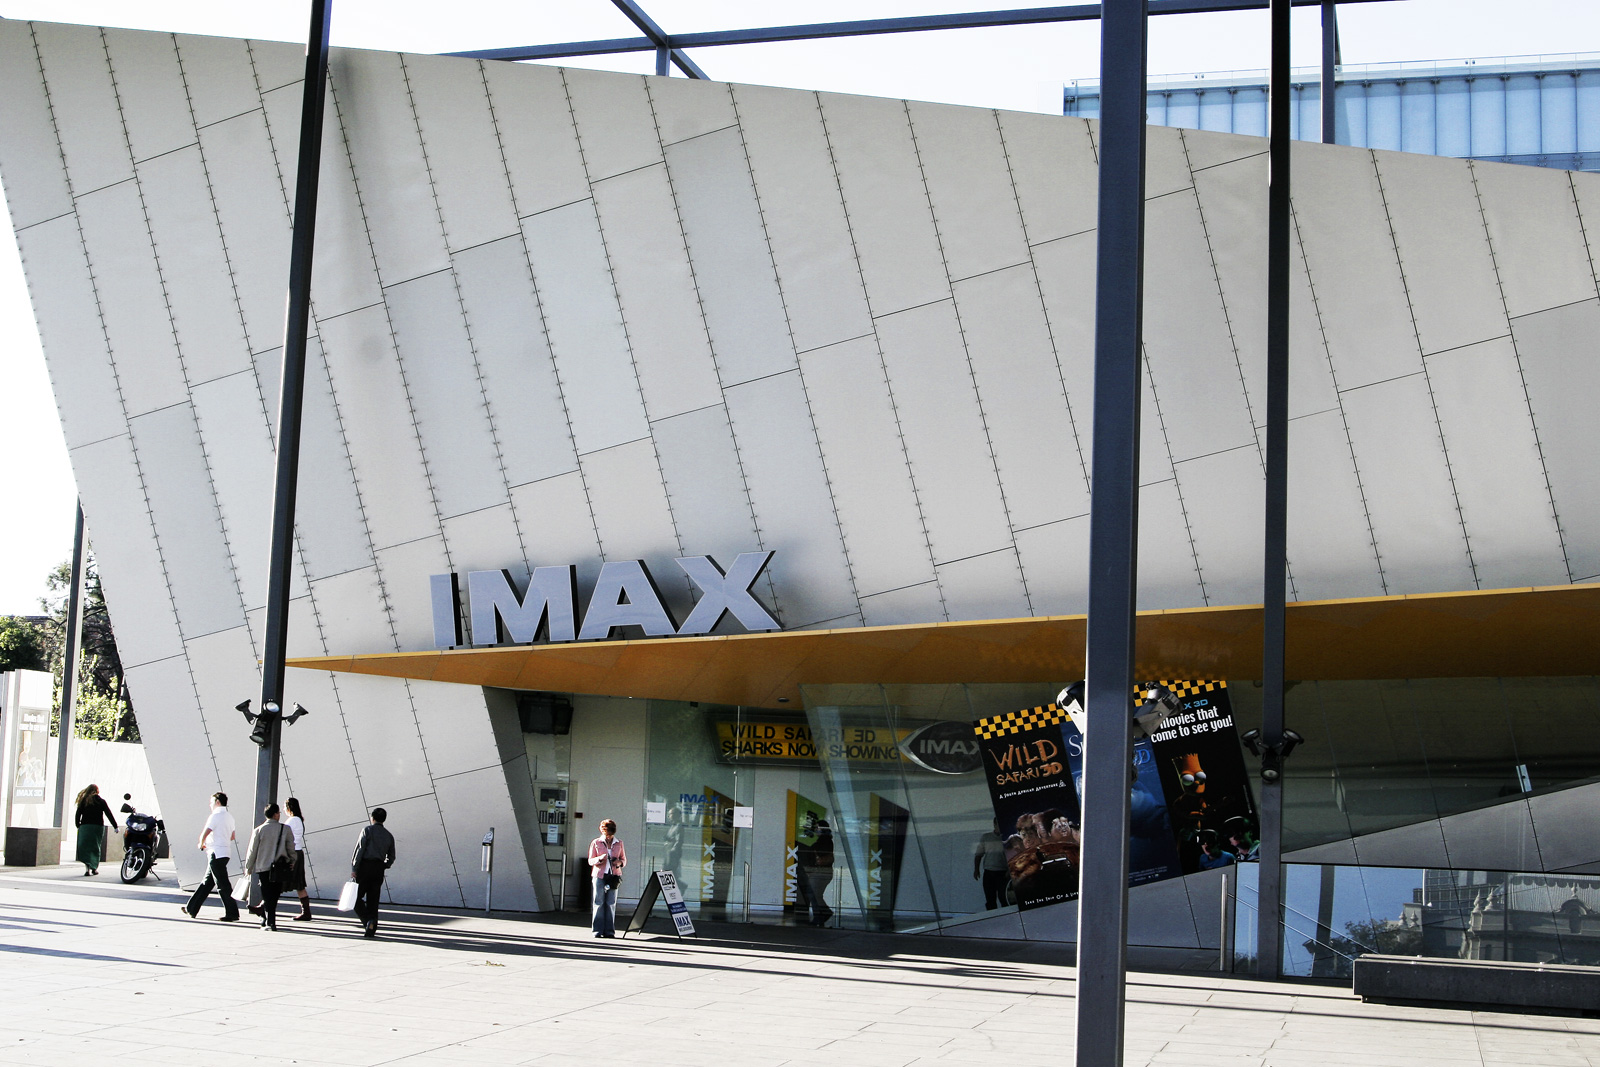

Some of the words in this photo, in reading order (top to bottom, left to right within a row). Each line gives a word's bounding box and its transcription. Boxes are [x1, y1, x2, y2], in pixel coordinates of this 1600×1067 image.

[430, 551, 783, 647] IMAX
[1193, 698, 1209, 708] 3D
[1196, 705, 1219, 721] that
[730, 724, 776, 739] WILD
[784, 726, 845, 743] SAFARI
[1150, 728, 1178, 743] come
[1179, 725, 1190, 737] to
[1191, 723, 1209, 735] see
[1210, 714, 1233, 733] you!
[721, 740, 783, 756] SHARKS
[829, 744, 900, 760] SHOWING
[919, 739, 979, 755] IMAX
[988, 739, 1058, 771] WILD
[996, 767, 1040, 786] SAFARI
[1040, 761, 1063, 777] 3D
[680, 793, 720, 804] IMAX
[702, 842, 716, 898] IMAX
[785, 845, 799, 902] IMAX
[869, 848, 882, 906] IMAX
[675, 915, 691, 927] IMAX
